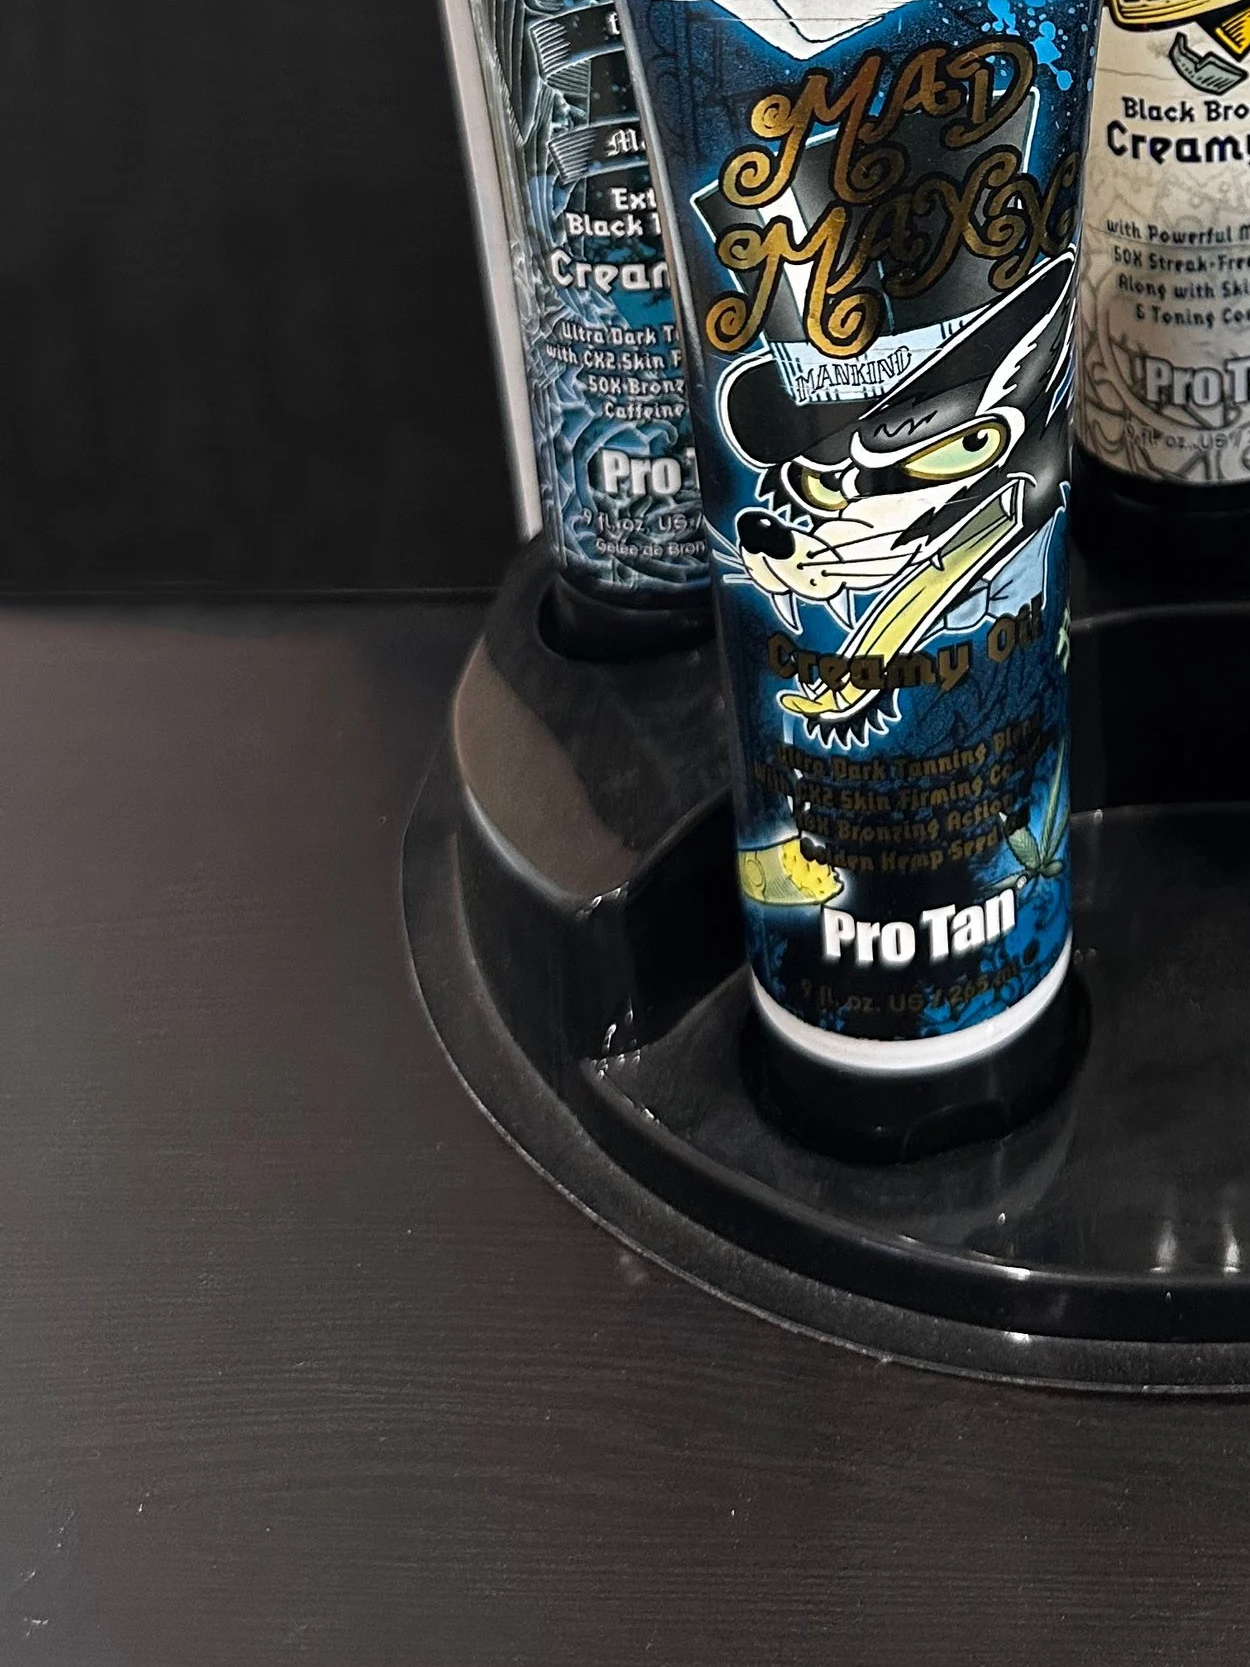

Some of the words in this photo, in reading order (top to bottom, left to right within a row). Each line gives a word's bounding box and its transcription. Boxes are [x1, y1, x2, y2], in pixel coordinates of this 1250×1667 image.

[1122, 96, 1195, 122] Black
[566, 213, 644, 237] Black
[1106, 219, 1142, 239] with
[1148, 224, 1232, 244] Powerful
[1114, 245, 1142, 267] 50X
[1118, 274, 1166, 301] Along
[1174, 282, 1214, 299] with
[1151, 306, 1214, 328] Toning
[562, 321, 605, 343] Ultra
[610, 327, 657, 345] Dark
[546, 344, 578, 364] with
[621, 352, 665, 370] Skin
[795, 345, 913, 402] MANKIND
[1145, 355, 1223, 407] Pro
[602, 449, 682, 496] Pro
[768, 634, 972, 691] Creamy
[832, 757, 886, 781] Dark
[894, 742, 986, 776] Tanning
[900, 774, 983, 810] Firming
[823, 907, 915, 966] Pro
[921, 888, 1016, 962] Tan
